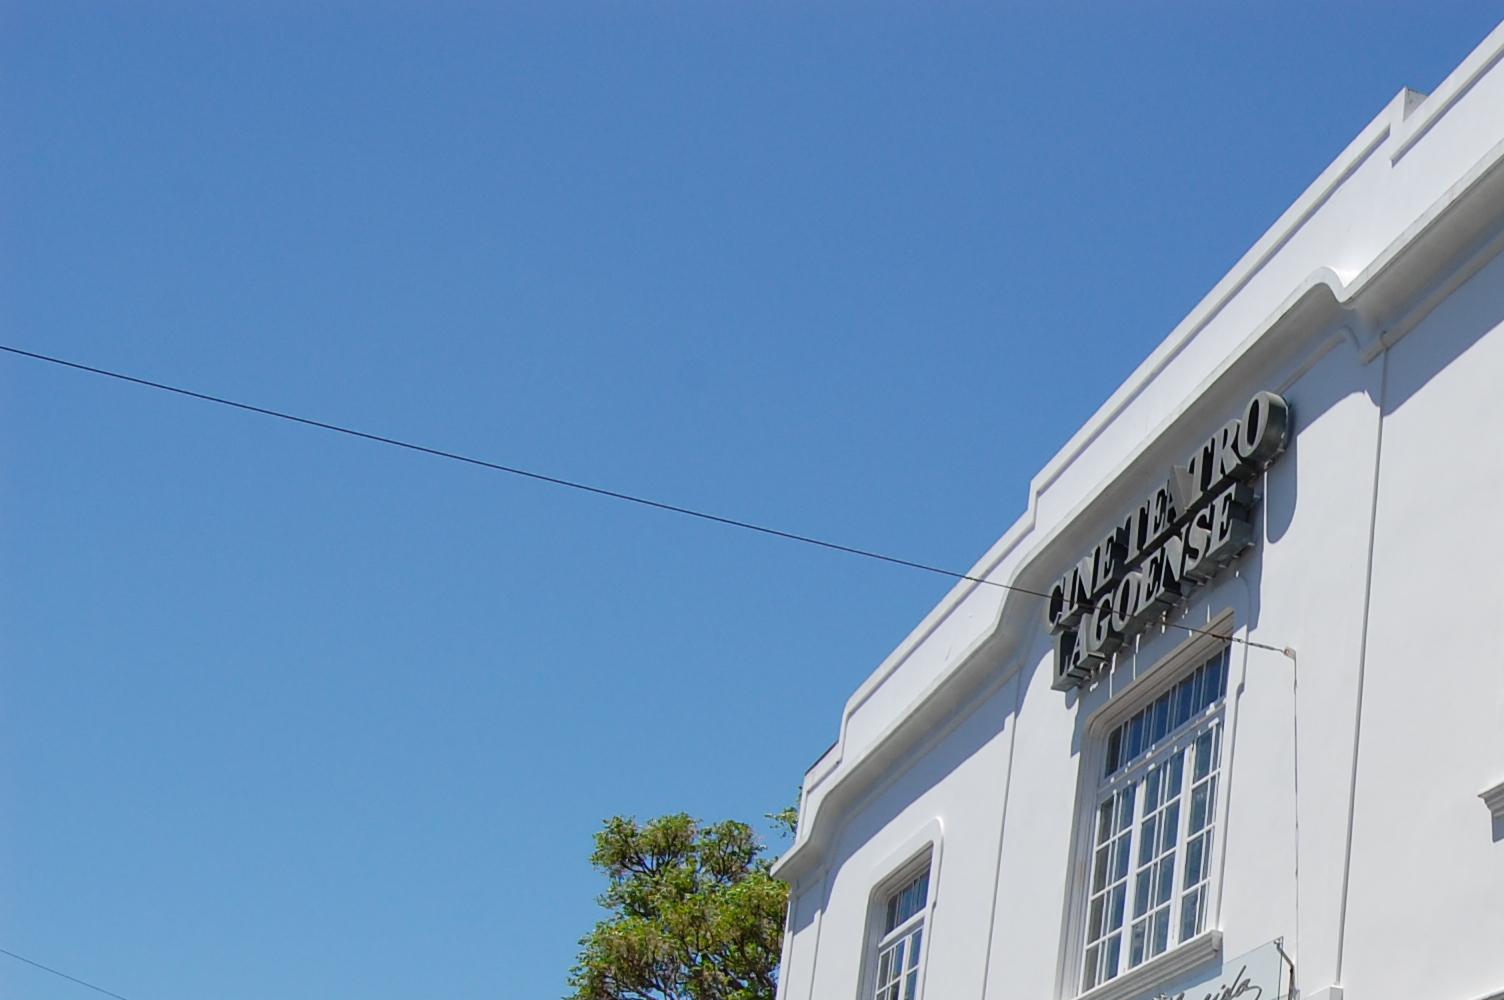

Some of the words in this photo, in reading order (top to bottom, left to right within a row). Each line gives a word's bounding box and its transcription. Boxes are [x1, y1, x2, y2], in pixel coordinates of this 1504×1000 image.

[1047, 526, 1125, 635] CINE
[1124, 390, 1287, 566] TEATRO
[1051, 484, 1250, 691] LAGOENSE
